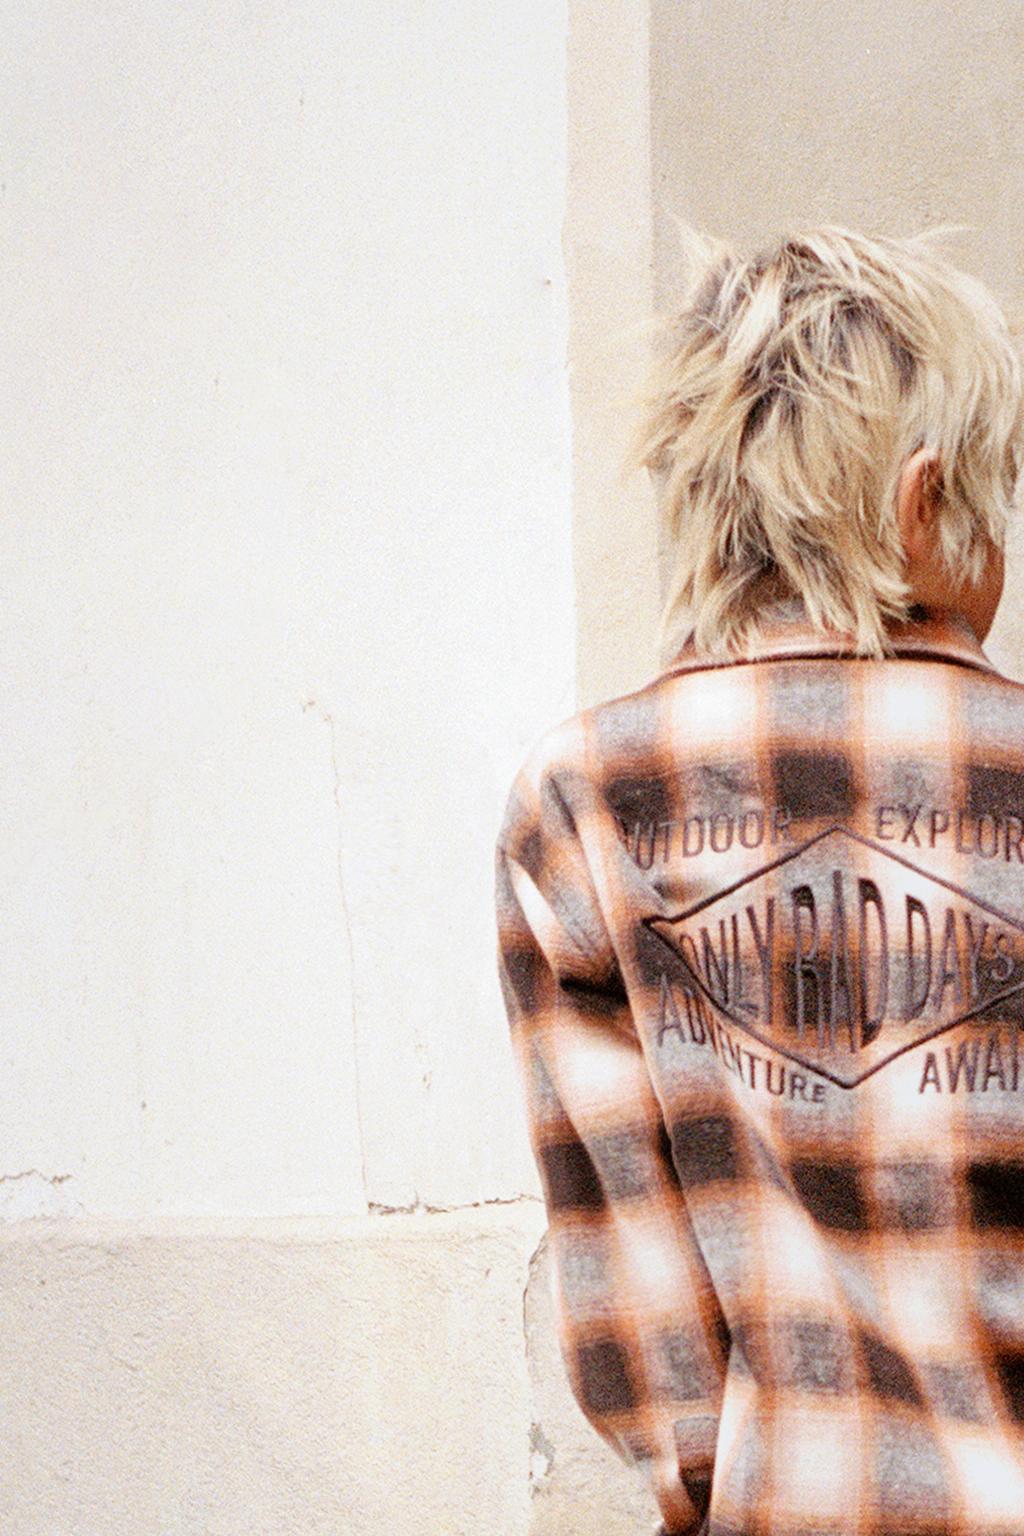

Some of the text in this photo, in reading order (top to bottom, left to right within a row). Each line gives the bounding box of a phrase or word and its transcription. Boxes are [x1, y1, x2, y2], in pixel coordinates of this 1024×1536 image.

[622, 806, 796, 871] UTDOOR
[679, 869, 1016, 1054] ONLY RAD DAYS
[658, 973, 827, 1103] ADVENTURE
